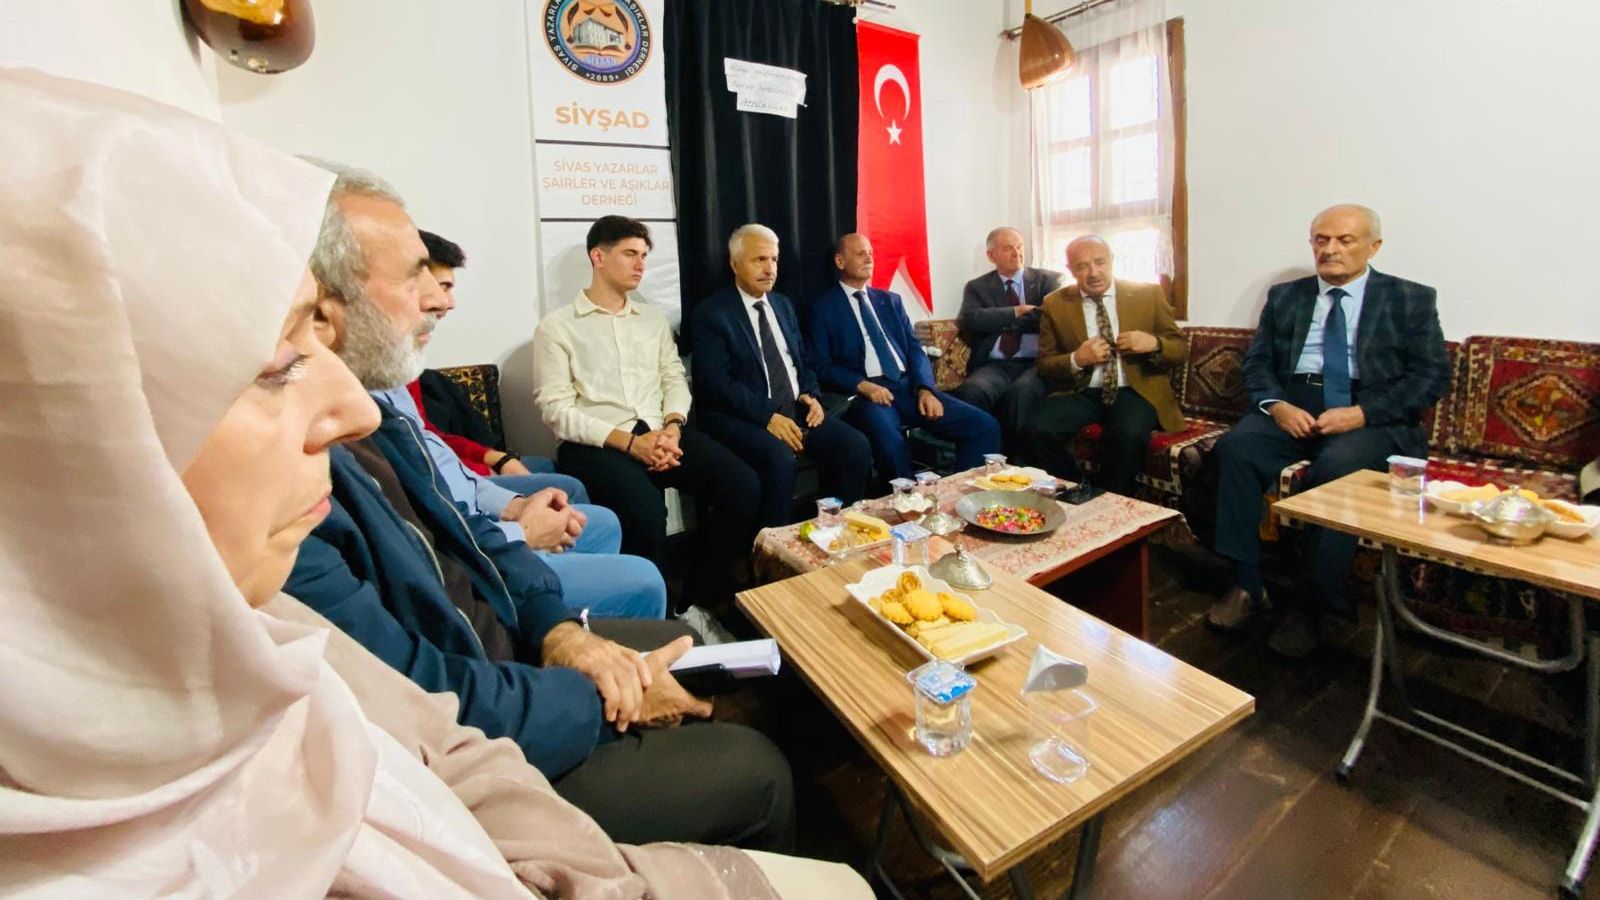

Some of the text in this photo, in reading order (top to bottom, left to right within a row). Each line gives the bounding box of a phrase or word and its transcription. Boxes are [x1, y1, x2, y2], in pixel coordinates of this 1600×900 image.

[555, 102, 650, 132] SİYŞAD
[553, 159, 658, 175] SİVAS YAZARLAR
[543, 176, 670, 193] ŞAİRLER VE AŞIKLAR
[582, 193, 637, 206] DERNEĞİ
